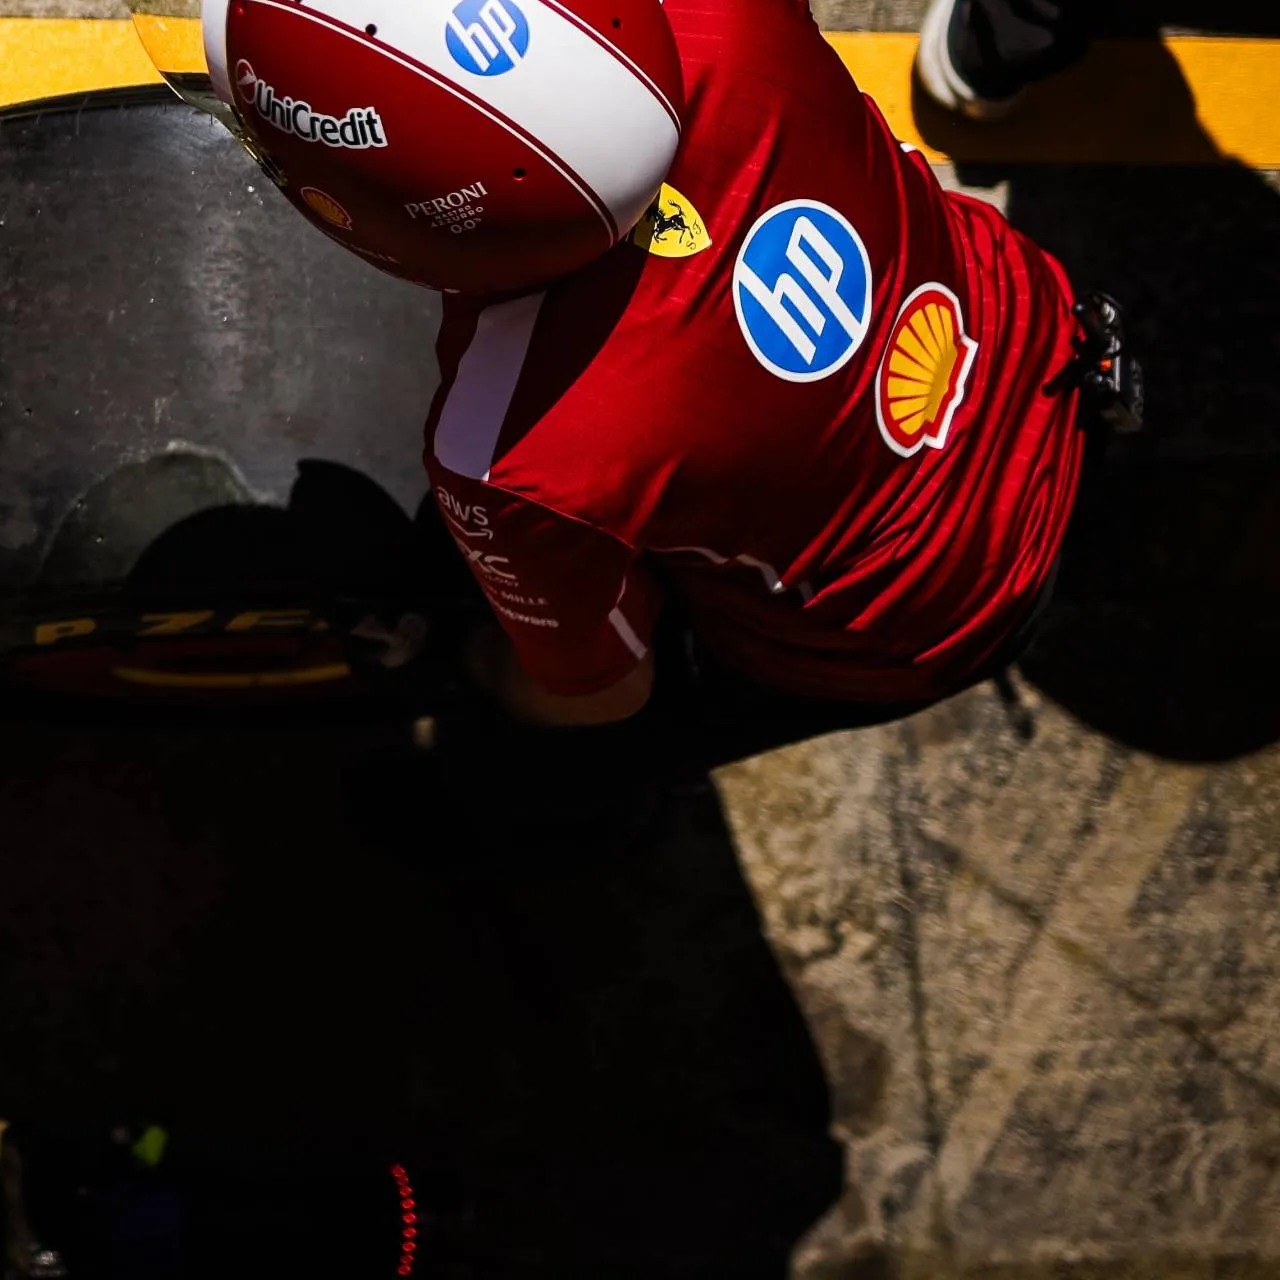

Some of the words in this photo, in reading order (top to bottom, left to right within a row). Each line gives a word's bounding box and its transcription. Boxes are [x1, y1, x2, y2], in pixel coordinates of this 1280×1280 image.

[255, 81, 388, 150] UniCredit
[403, 180, 489, 220] PERONI
[737, 213, 862, 367] hp
[436, 485, 490, 527] aws
